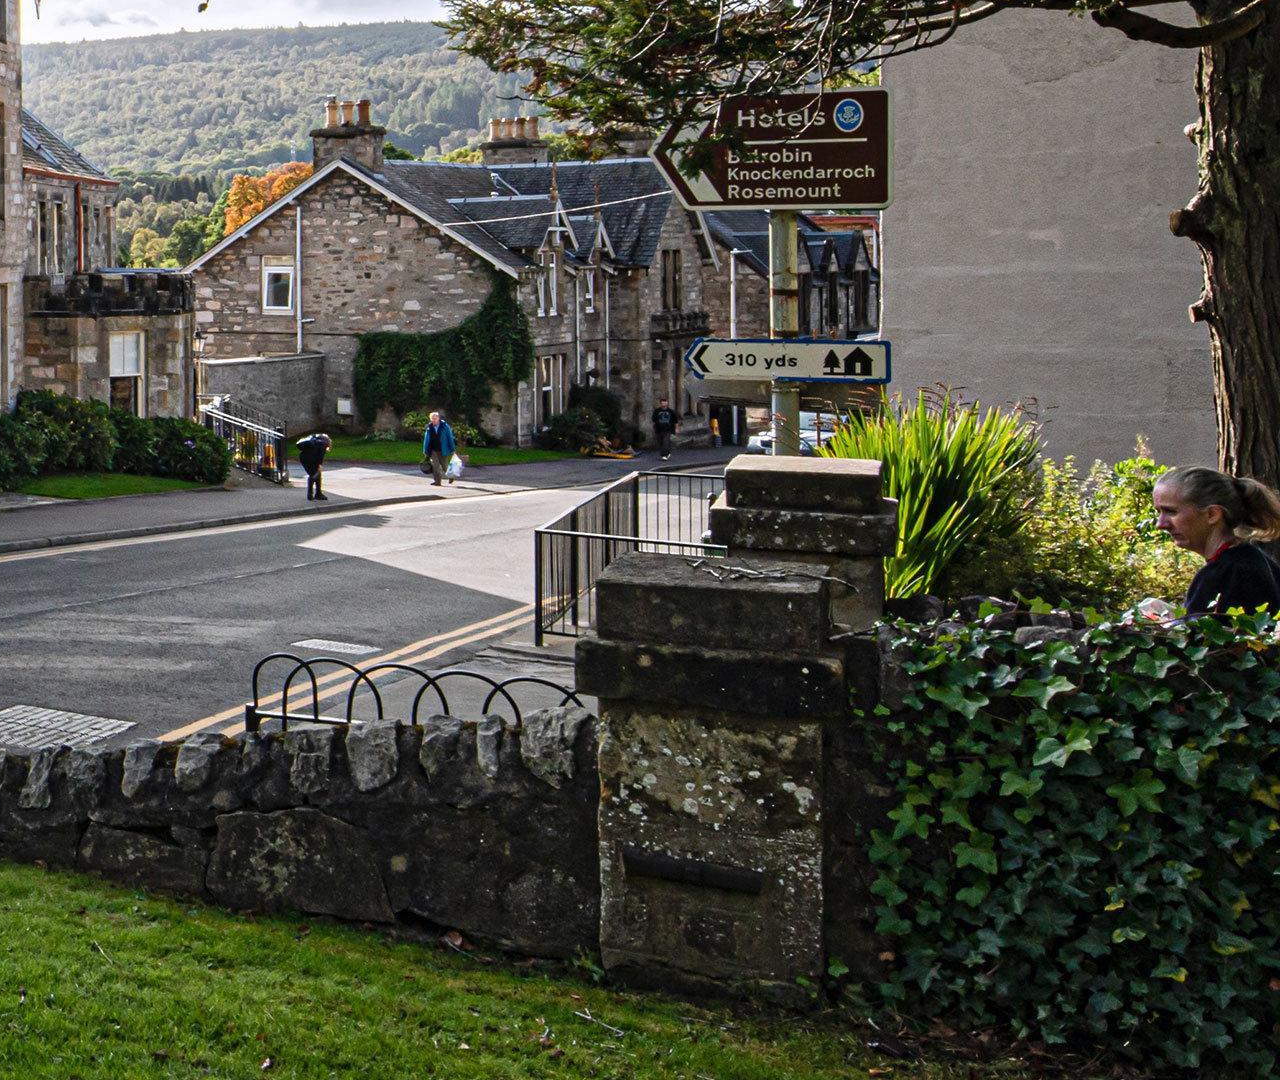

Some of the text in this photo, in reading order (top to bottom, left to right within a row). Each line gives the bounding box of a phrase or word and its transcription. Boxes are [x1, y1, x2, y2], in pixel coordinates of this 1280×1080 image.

[737, 108, 826, 129] Hotels
[727, 164, 876, 181] Knockendarroch
[727, 183, 842, 200] Rosemount
[724, 353, 798, 370] 310 yds
